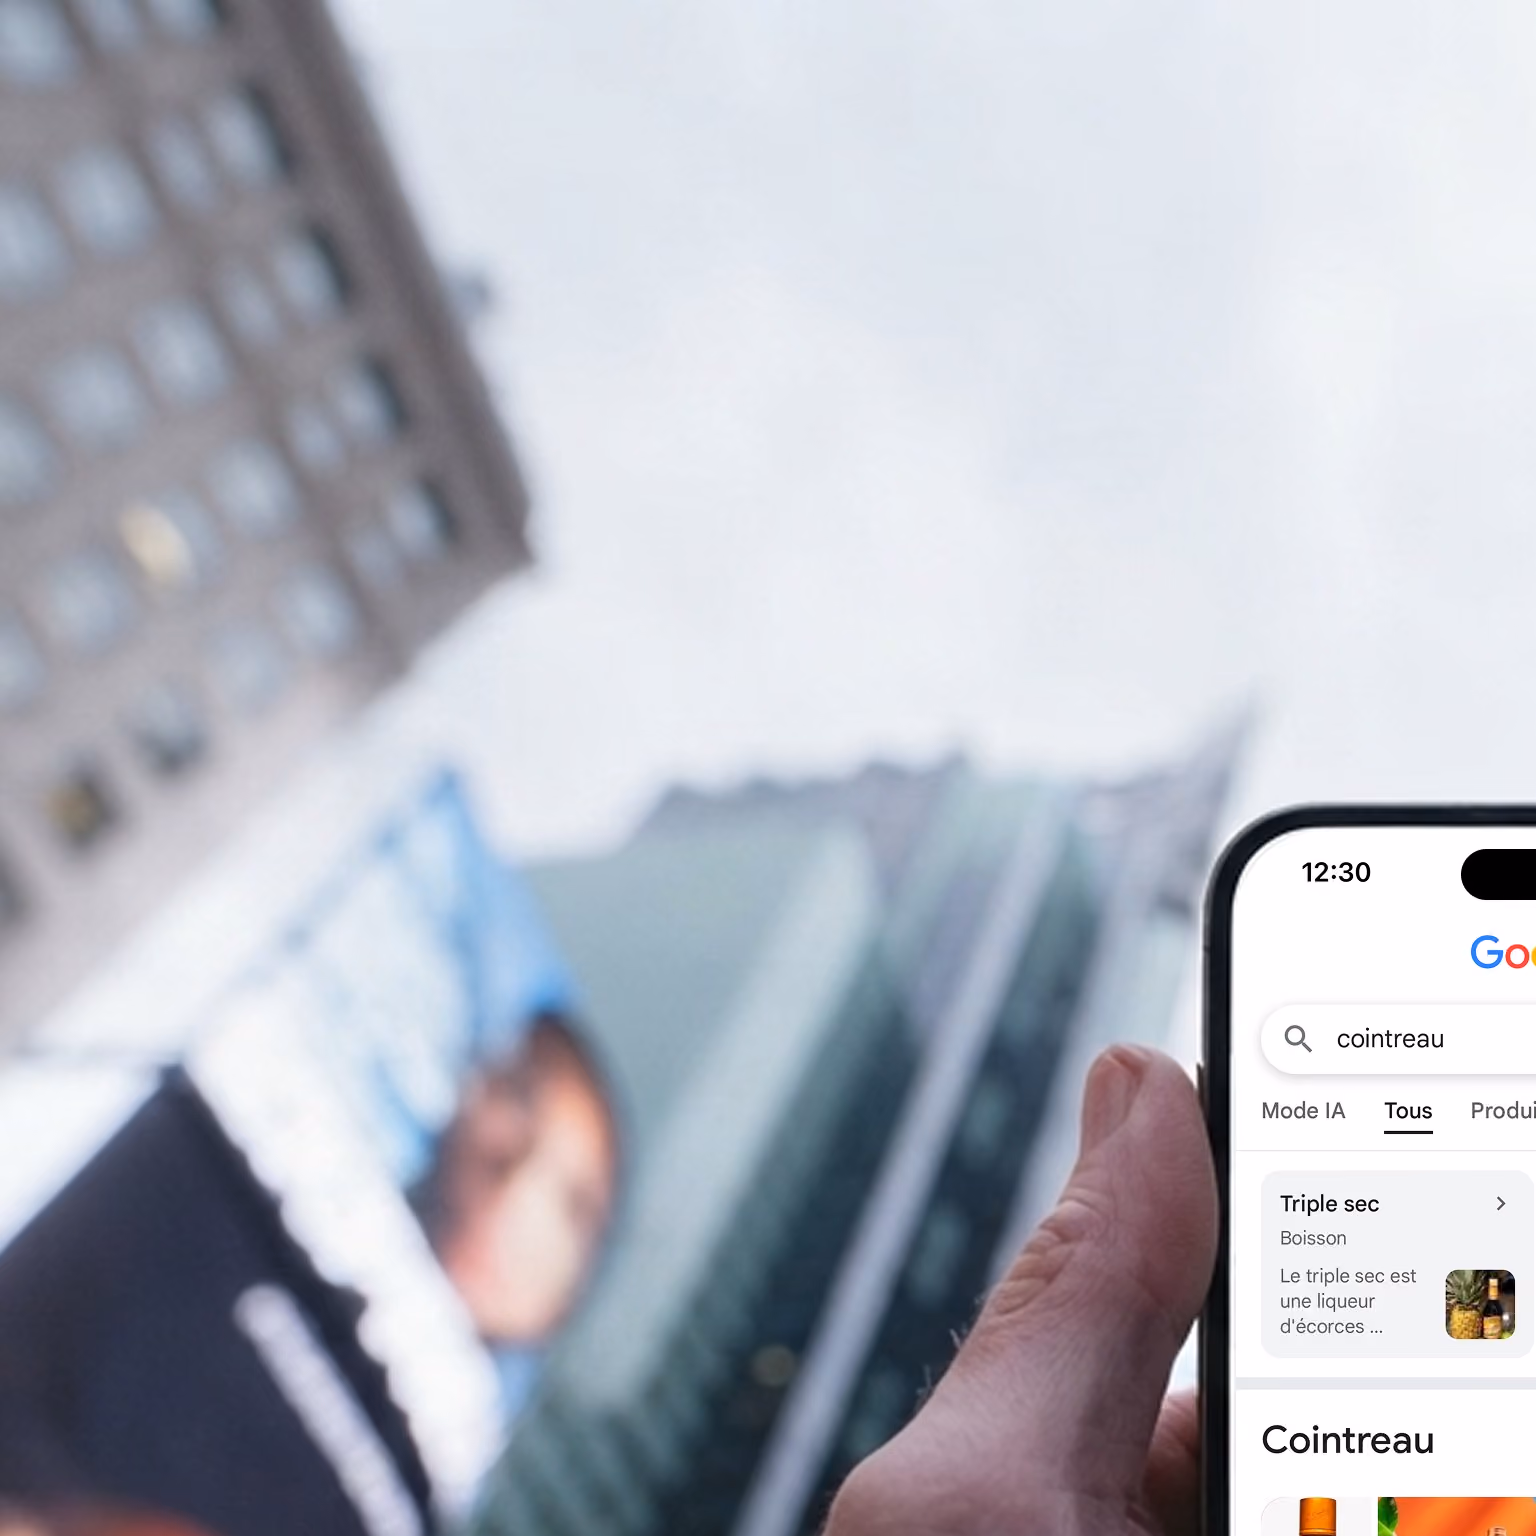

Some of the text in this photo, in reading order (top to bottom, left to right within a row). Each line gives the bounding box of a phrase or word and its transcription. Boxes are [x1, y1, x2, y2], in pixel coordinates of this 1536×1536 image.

[1302, 862, 1371, 883] 12:30
[1337, 1026, 1444, 1049] cointreau
[1262, 1101, 1346, 1120] Mode IA
[1384, 1101, 1433, 1120] Tous
[1280, 1193, 1380, 1217] Triple sec
[1280, 1229, 1347, 1246] Boisson
[1280, 1267, 1417, 1288] Le triple sec est
[1280, 1292, 1375, 1313] une liqueur
[1280, 1317, 1365, 1334] d'écorces
[1262, 1424, 1434, 1455] Cointreau
